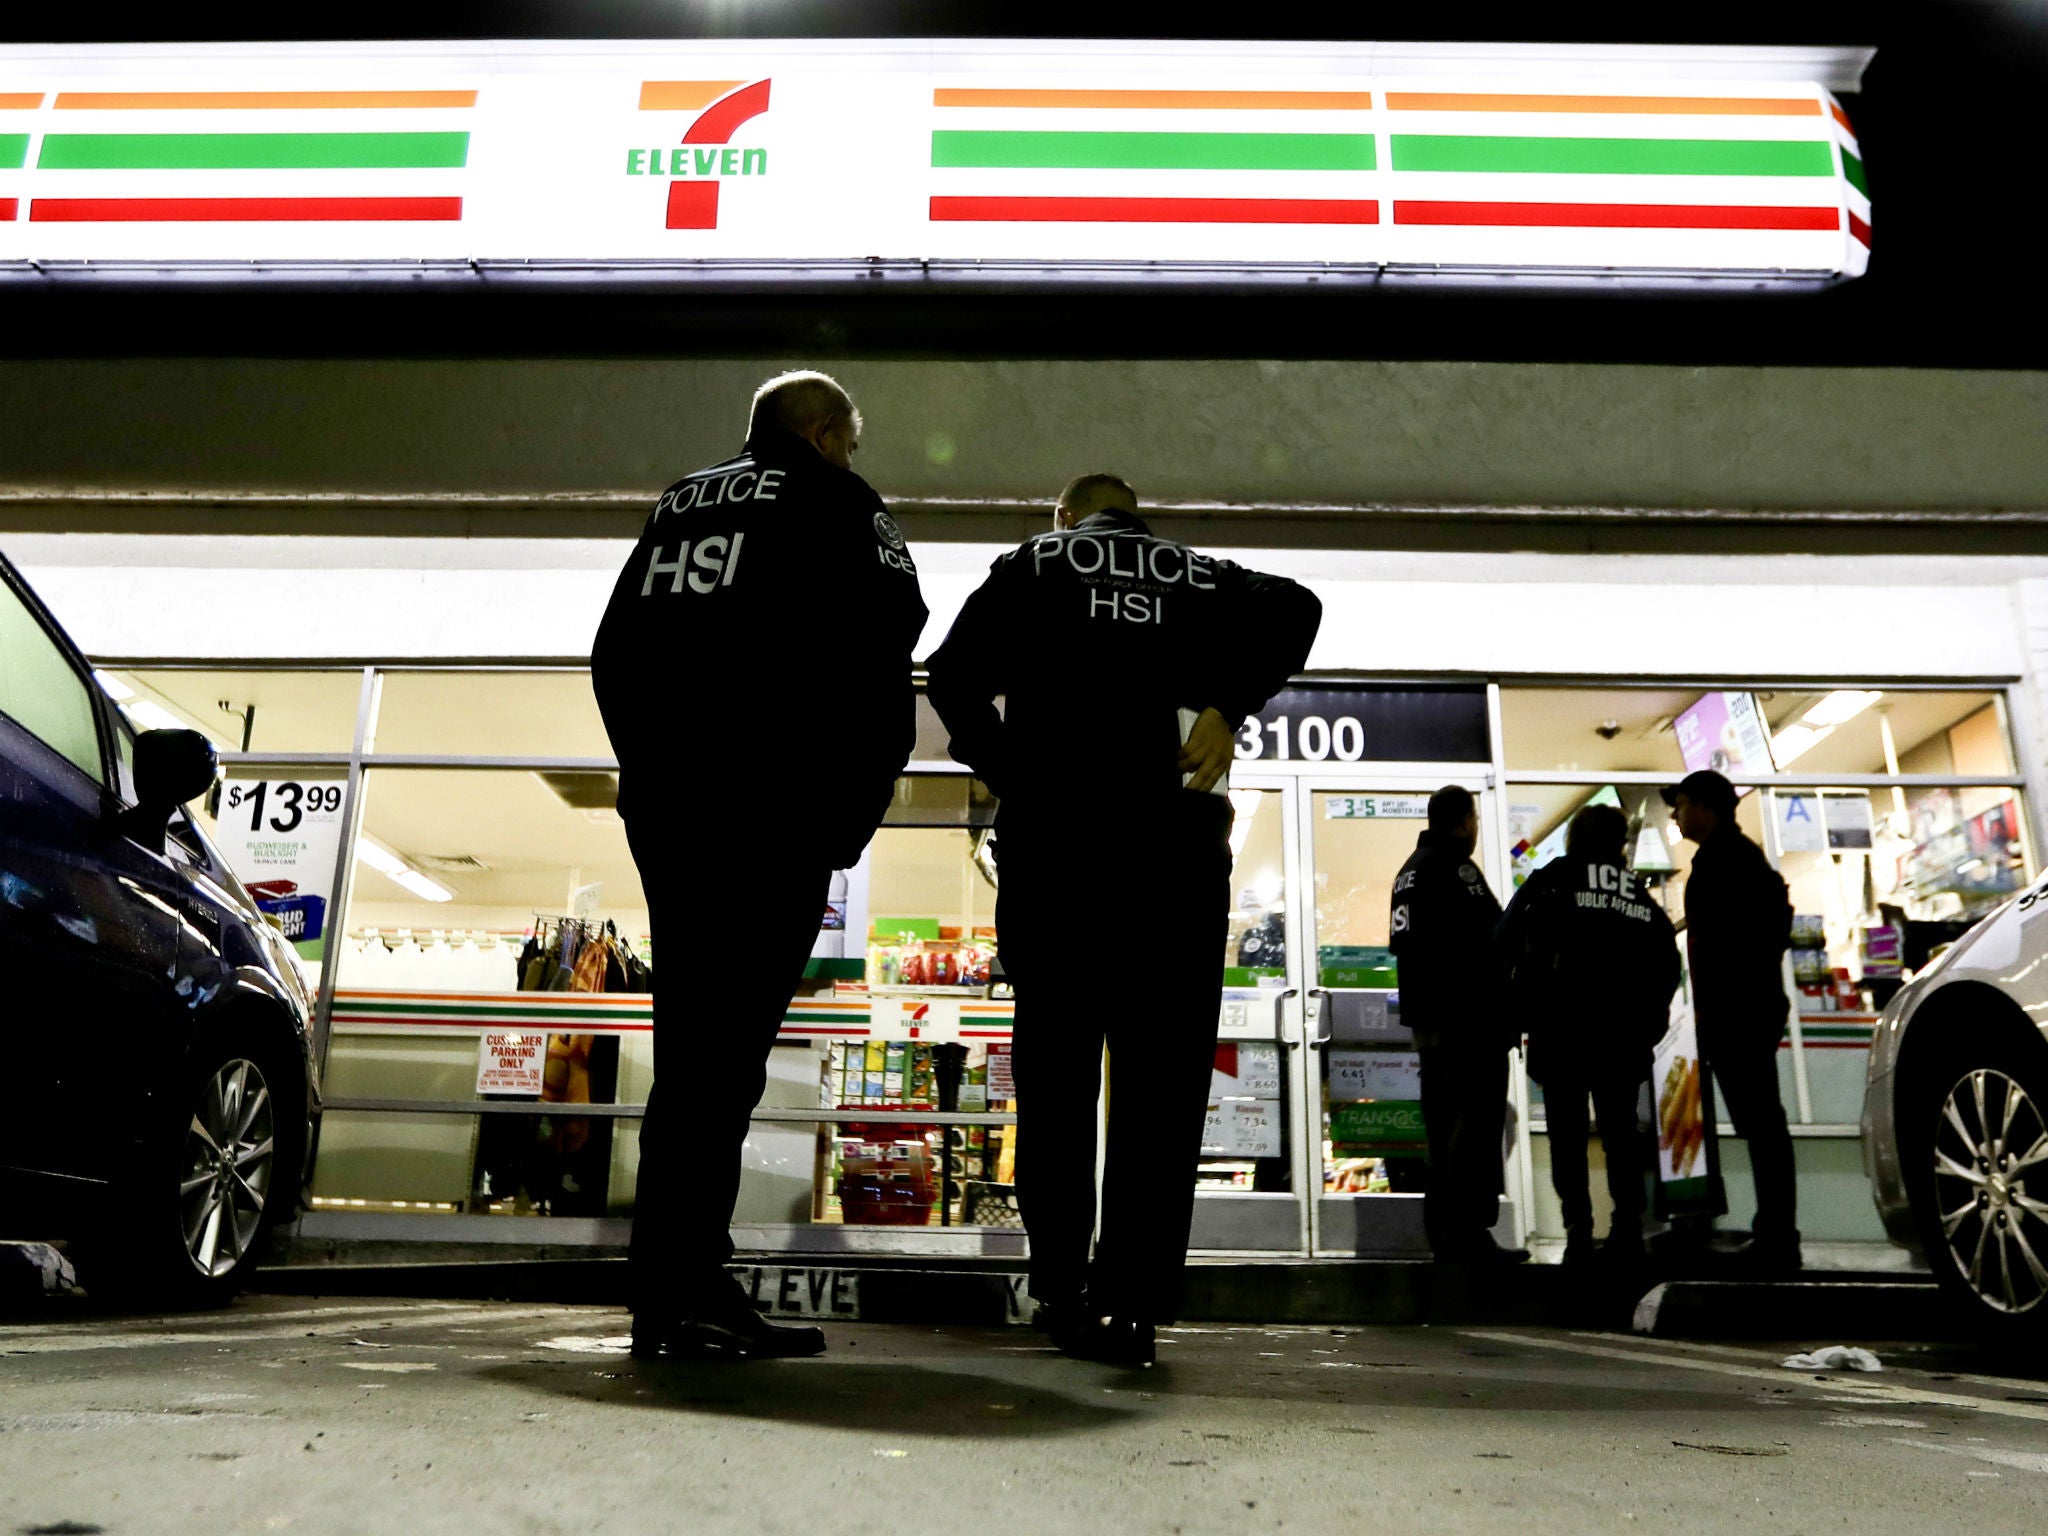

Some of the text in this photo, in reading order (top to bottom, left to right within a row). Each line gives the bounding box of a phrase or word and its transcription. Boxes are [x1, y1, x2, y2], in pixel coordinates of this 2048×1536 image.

[638, 78, 772, 229] 7
[654, 469, 786, 524] POLICE
[641, 532, 745, 597] HSI
[878, 545, 916, 576] ICE
[1033, 536, 1216, 590] POLICE
[1090, 588, 1161, 624] HSI
[1233, 715, 1365, 761] 3100
[1786, 796, 1811, 822] A
[1586, 864, 1637, 899] ICE
[902, 1003, 929, 1038] 7
[491, 1046, 535, 1058] PARKING
[499, 1058, 524, 1069] ONLY
